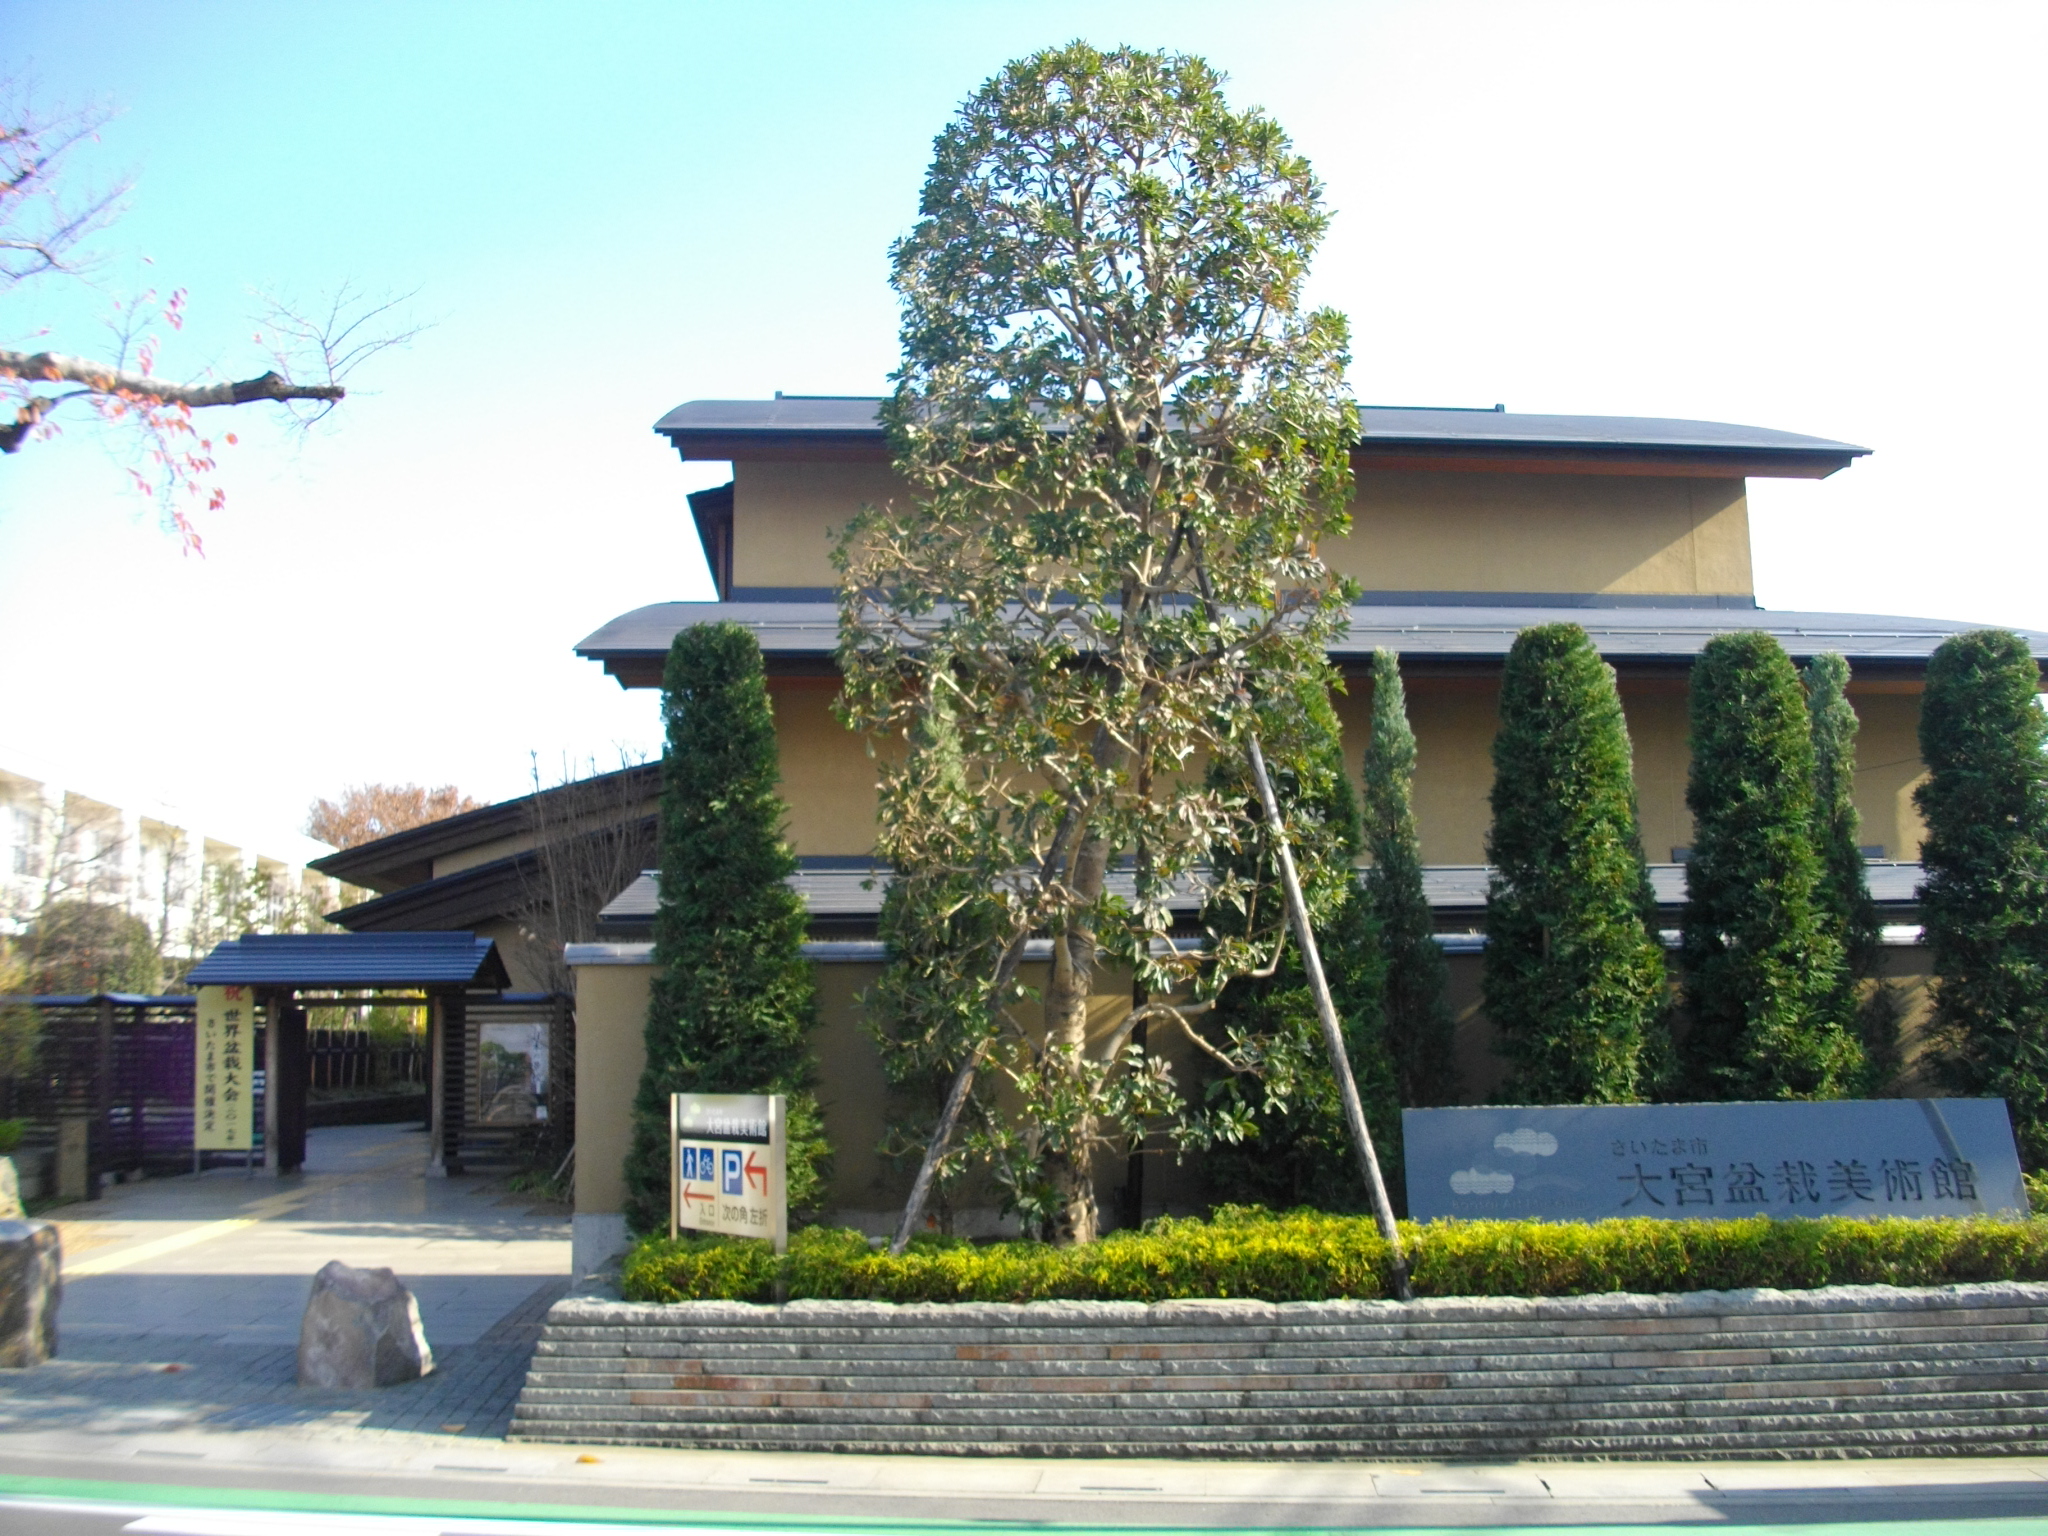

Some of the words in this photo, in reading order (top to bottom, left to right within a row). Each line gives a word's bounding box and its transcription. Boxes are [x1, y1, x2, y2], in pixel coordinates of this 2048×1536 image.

[1611, 1138, 1708, 1156] さいたま市
[725, 1153, 741, 1191] P
[1616, 1157, 1978, 1207] 大宮盆栽美術館
